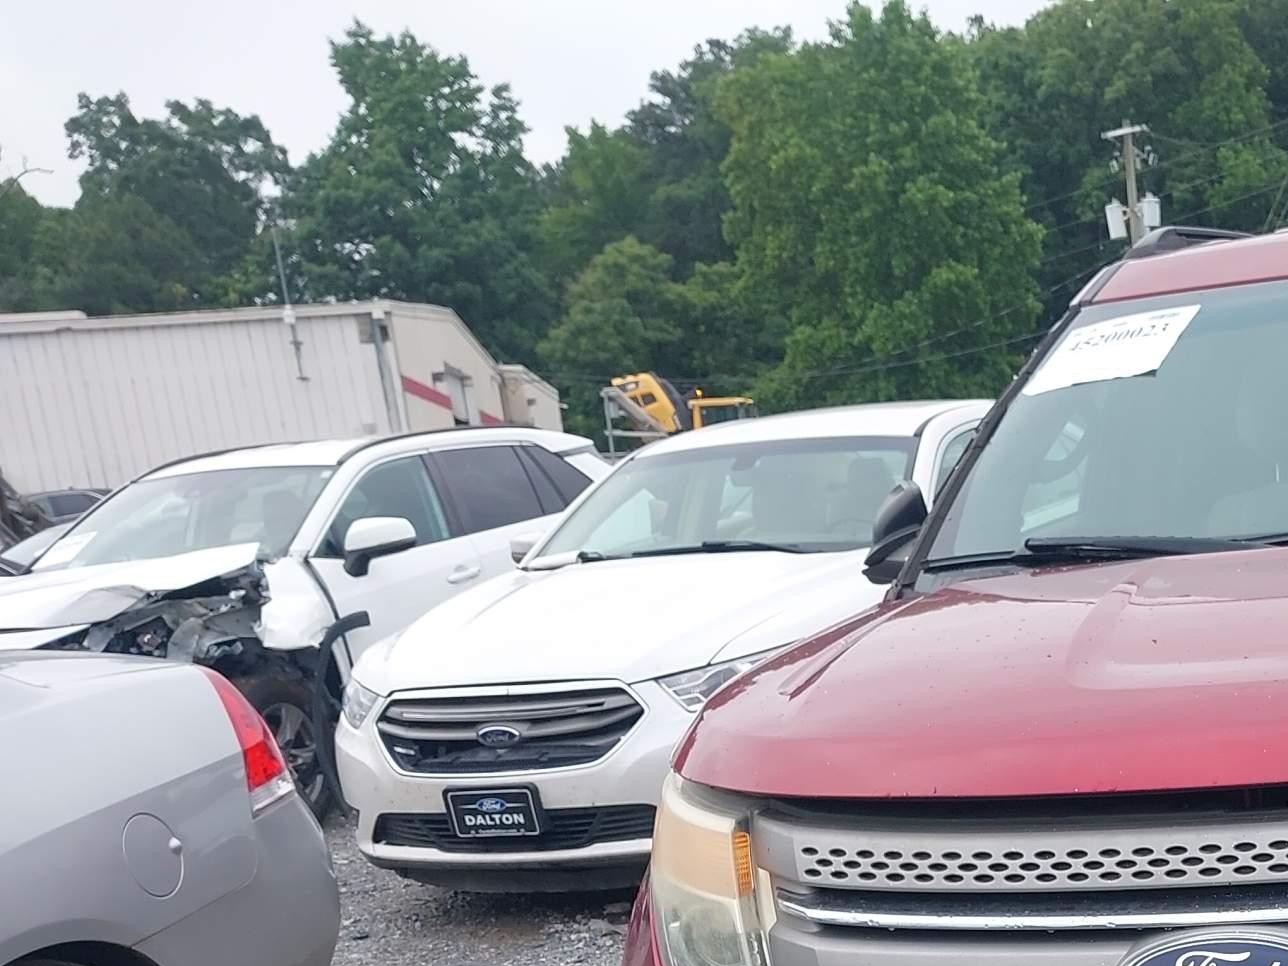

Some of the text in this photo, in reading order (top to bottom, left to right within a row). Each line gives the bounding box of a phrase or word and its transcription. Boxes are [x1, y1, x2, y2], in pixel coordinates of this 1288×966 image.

[485, 731, 509, 744] Ford
[481, 799, 503, 812] Ford
[463, 813, 526, 827] DALTON
